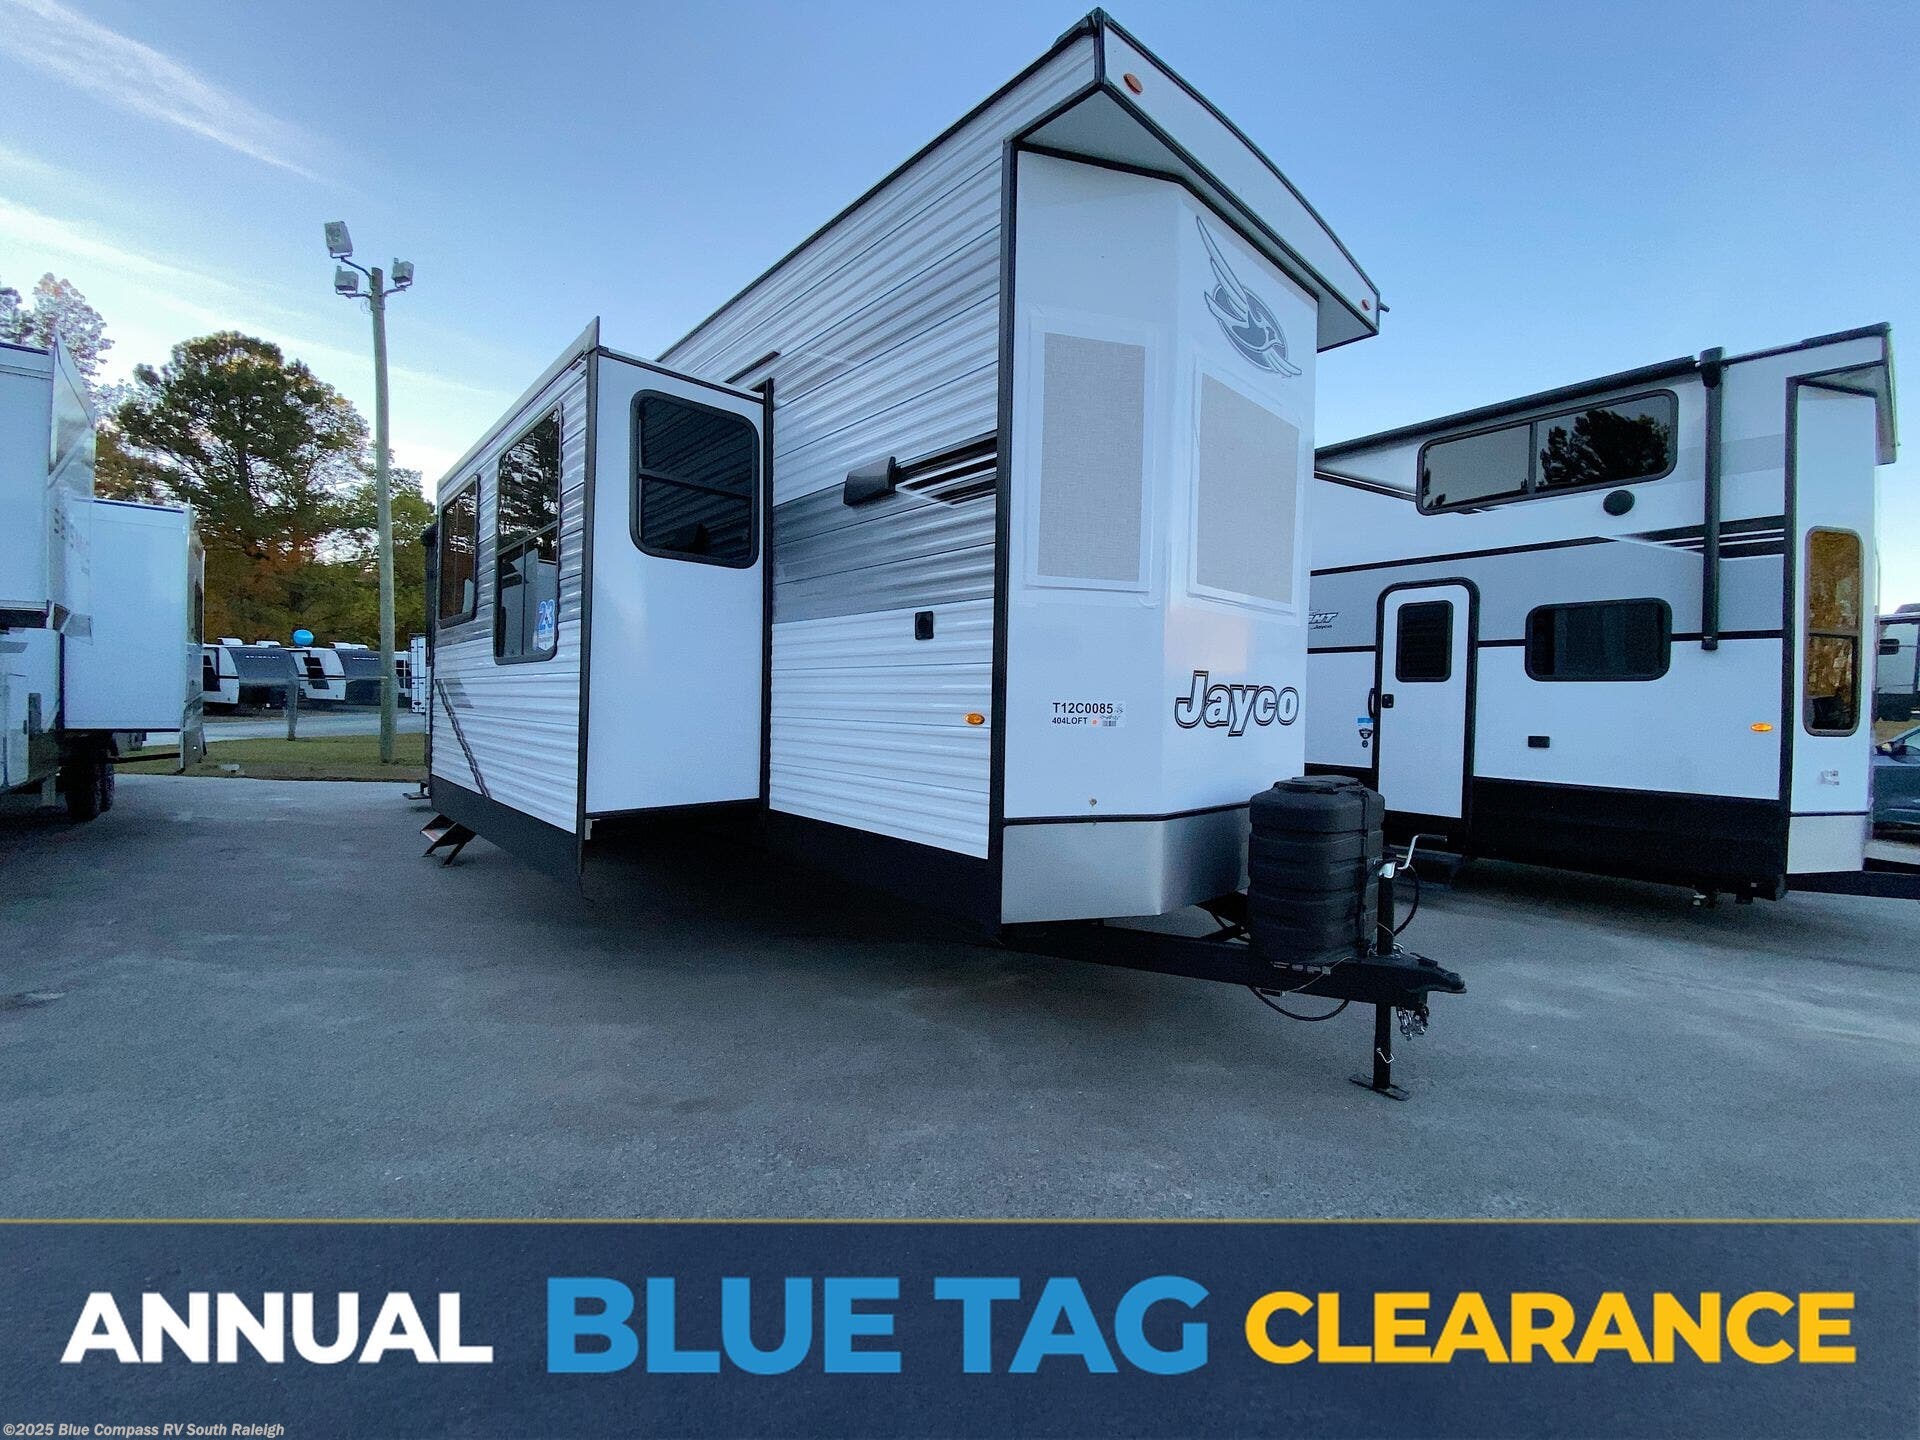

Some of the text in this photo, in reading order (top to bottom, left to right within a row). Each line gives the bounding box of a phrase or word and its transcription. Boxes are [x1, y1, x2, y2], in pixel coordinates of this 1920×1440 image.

[1052, 702, 1114, 714] T12C0085
[1174, 670, 1300, 737] Jayco
[1052, 717, 1088, 725] 404LOFT
